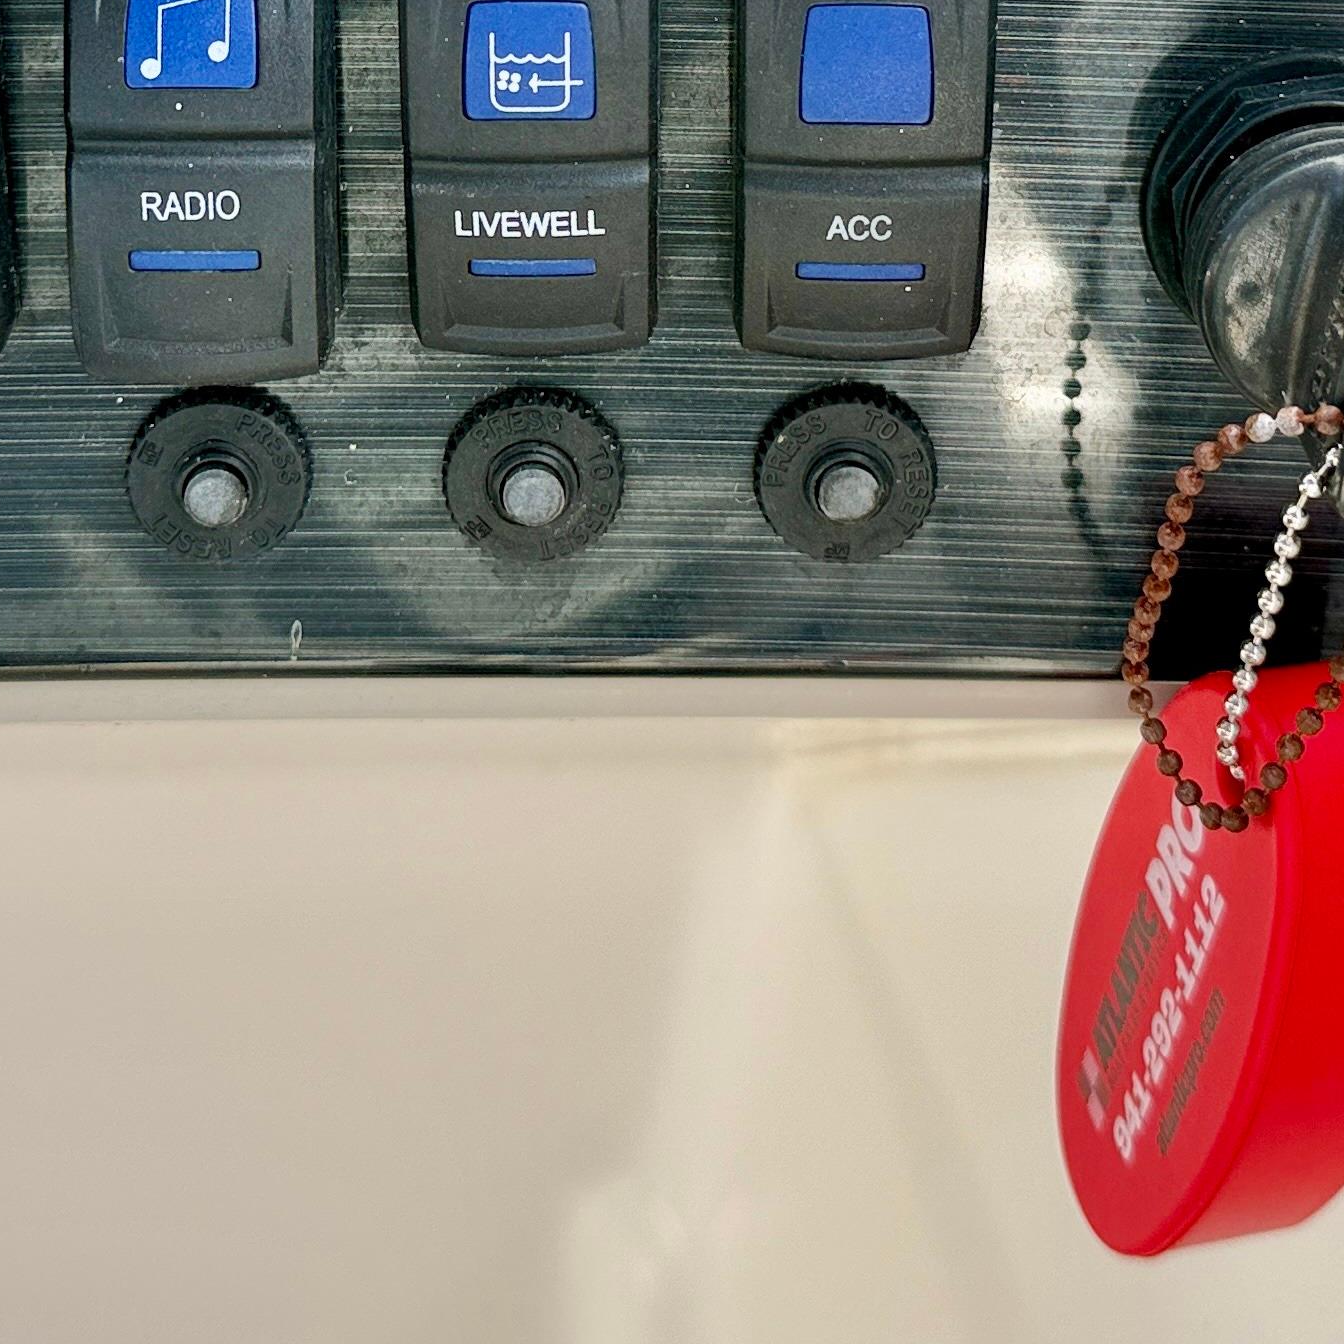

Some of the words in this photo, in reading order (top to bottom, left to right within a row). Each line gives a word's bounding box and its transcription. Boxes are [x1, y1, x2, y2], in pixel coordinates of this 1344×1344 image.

[140, 189, 241, 222] RADIO
[454, 209, 606, 238] LIVEWELL
[825, 214, 893, 242] ACC
[472, 410, 562, 448] PRESS
[236, 414, 301, 485] PRESS
[762, 413, 827, 488] PRESS
[865, 409, 899, 440] TO
[894, 447, 929, 535] RESET
[247, 518, 286, 547] TO
[1093, 890, 1159, 1071] ATLANTIC
[1144, 784, 1204, 931] PRO
[1113, 873, 1226, 1162] 941-292-1112
